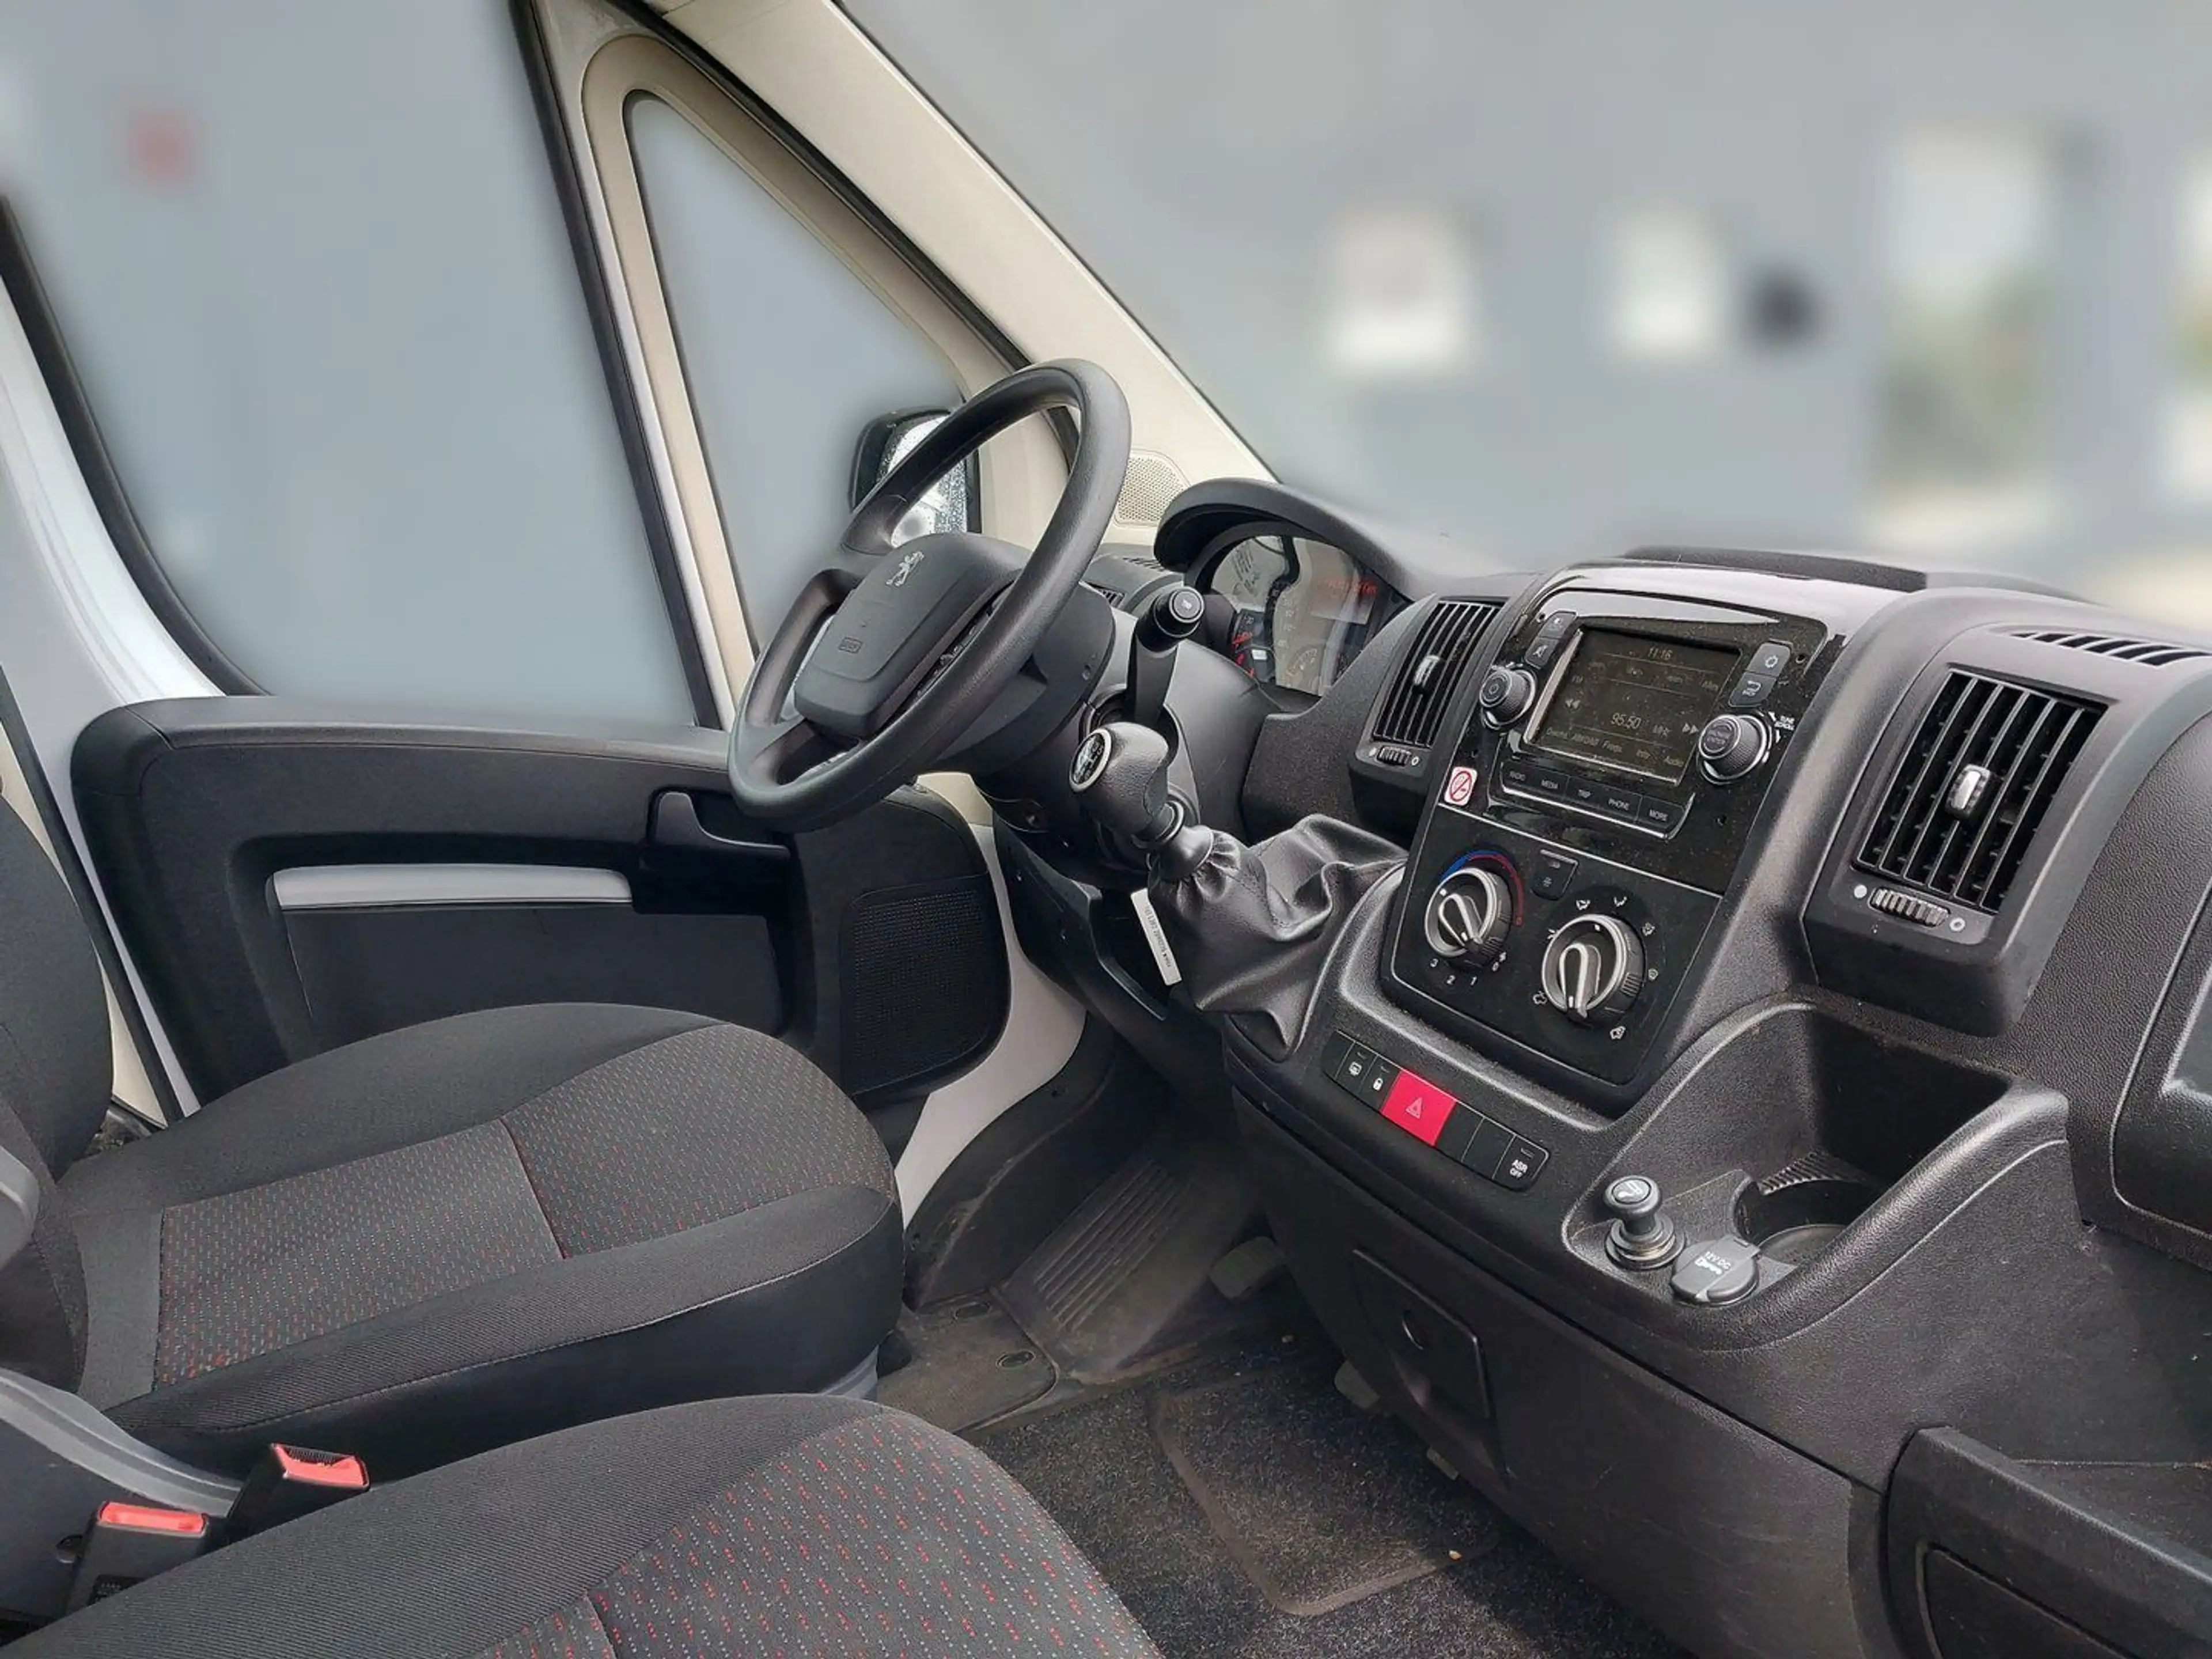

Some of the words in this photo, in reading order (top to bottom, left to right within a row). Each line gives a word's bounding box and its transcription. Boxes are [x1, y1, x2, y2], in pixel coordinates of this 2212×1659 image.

[1649, 809, 1669, 822] MORE
[1430, 958, 1439, 968] 3
[1446, 975, 1456, 986] 2
[1470, 976, 1478, 986] 1
[1512, 1159, 1528, 1173] ASR
